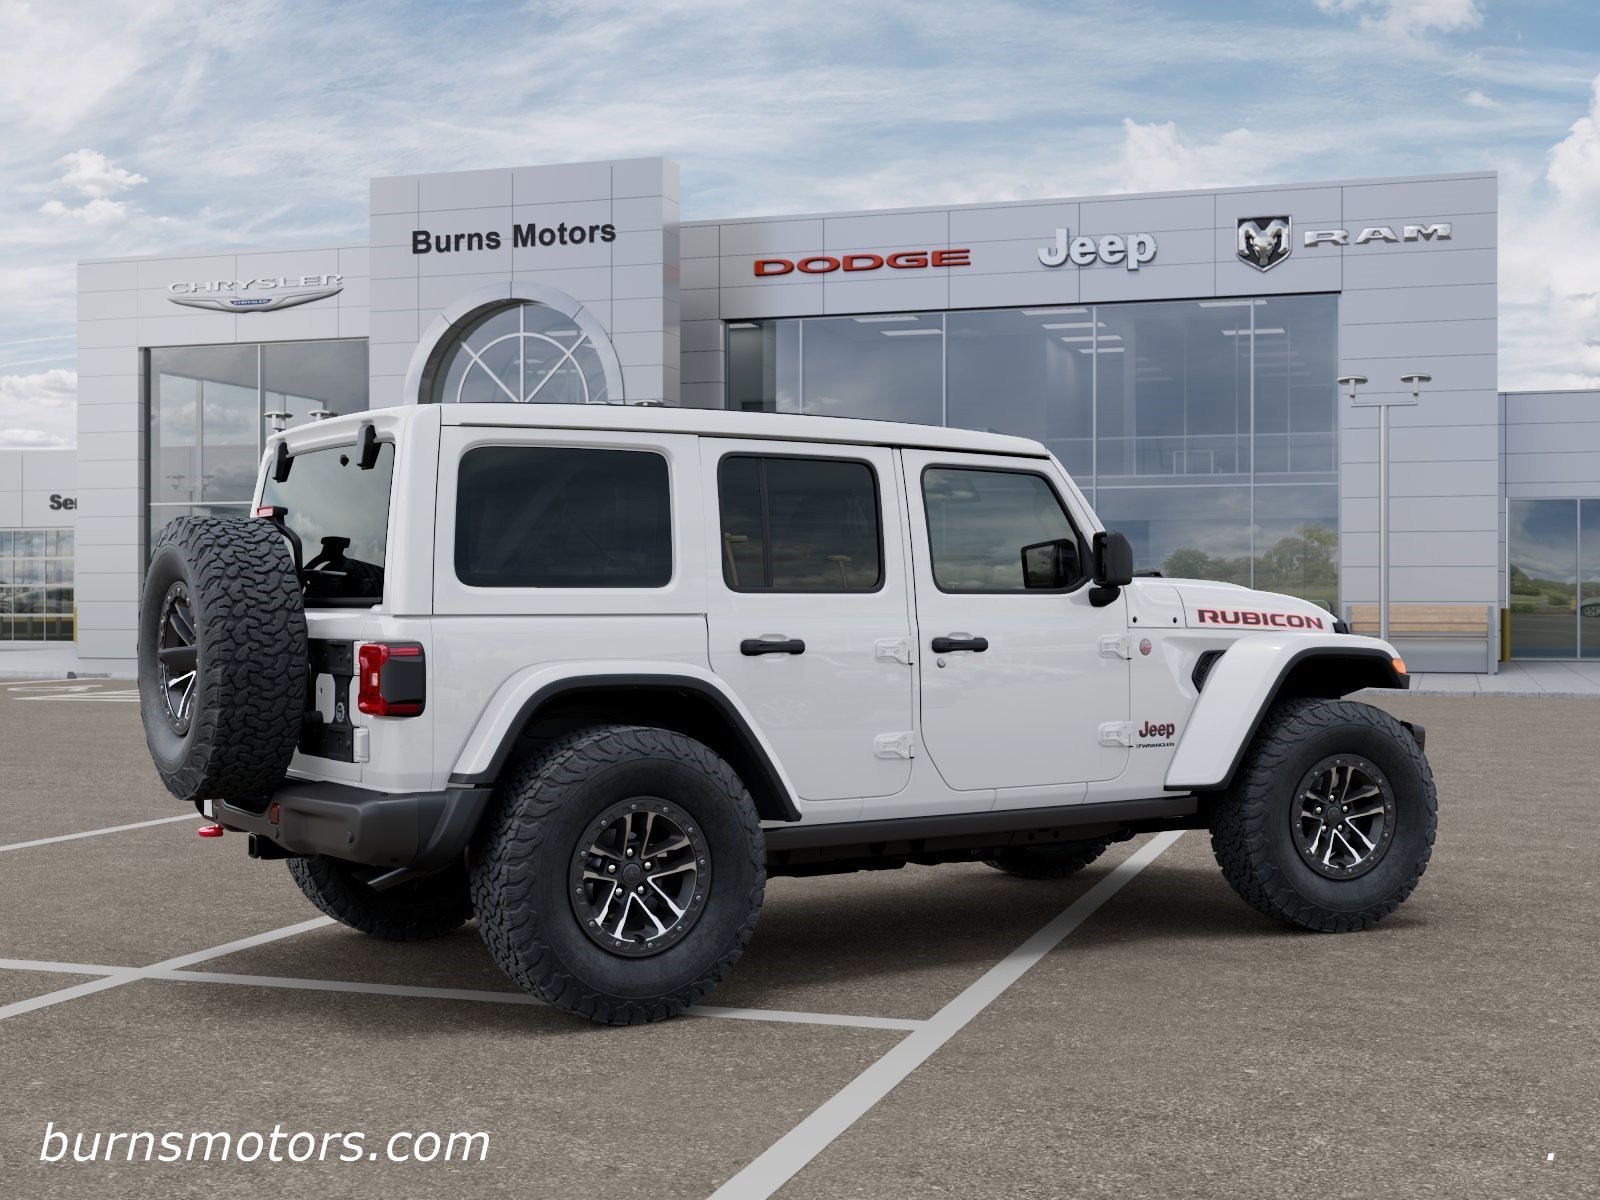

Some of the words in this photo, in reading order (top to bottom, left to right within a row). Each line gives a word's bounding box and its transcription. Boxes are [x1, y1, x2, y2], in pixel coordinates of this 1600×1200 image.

[412, 230, 501, 254] Burns
[512, 221, 616, 248] Motors
[1304, 223, 1452, 248] RAM
[1037, 227, 1157, 271] Jeep
[754, 248, 971, 277] DODGE
[167, 273, 343, 294] CHRYSLER
[1198, 609, 1324, 630] RUBICON
[1138, 720, 1176, 739] Jeep
